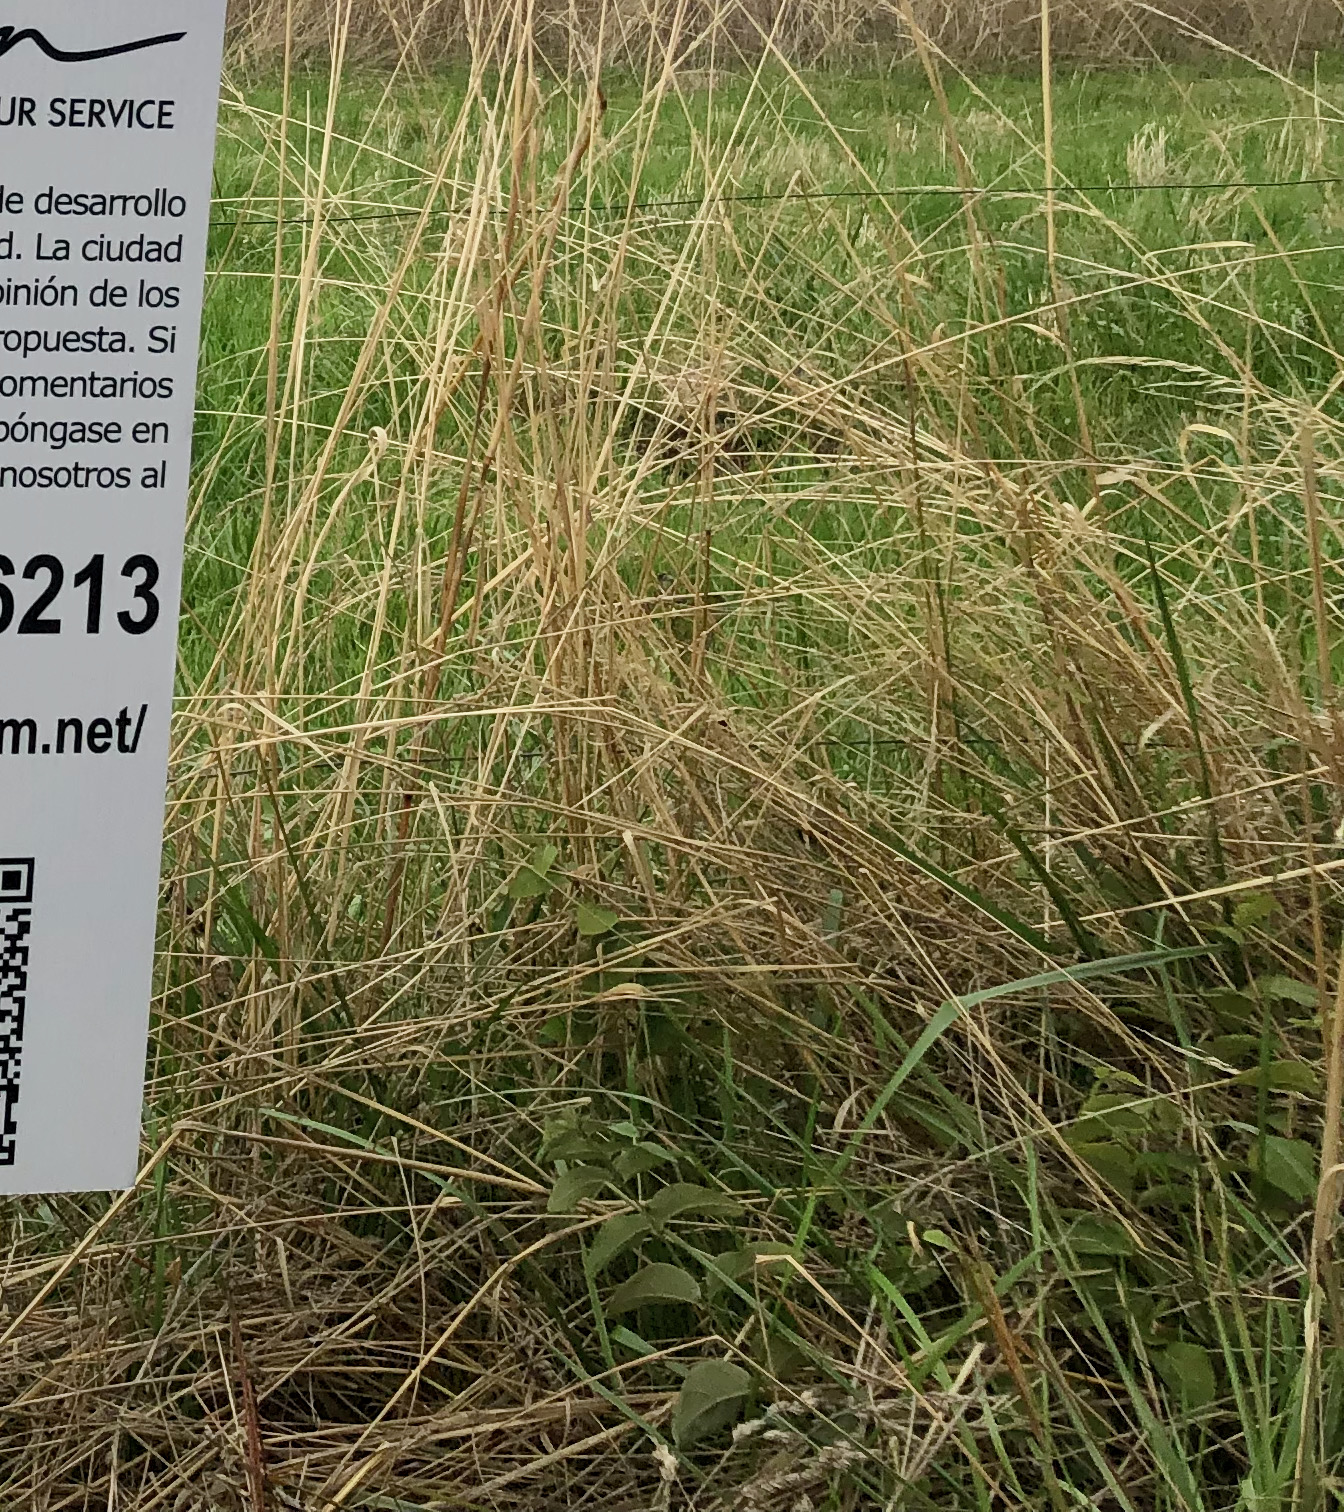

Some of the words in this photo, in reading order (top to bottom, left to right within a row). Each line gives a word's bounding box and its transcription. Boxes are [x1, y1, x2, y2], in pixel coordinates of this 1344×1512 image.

[49, 98, 174, 129] SERVICE
[35, 186, 186, 217] desarrollo
[36, 233, 70, 261] La
[82, 234, 183, 262] ciudad
[90, 279, 127, 307] de
[139, 279, 179, 308] los
[148, 326, 176, 353] Si
[132, 423, 168, 443] en
[0, 462, 131, 488] nosotros
[141, 460, 166, 488] al
